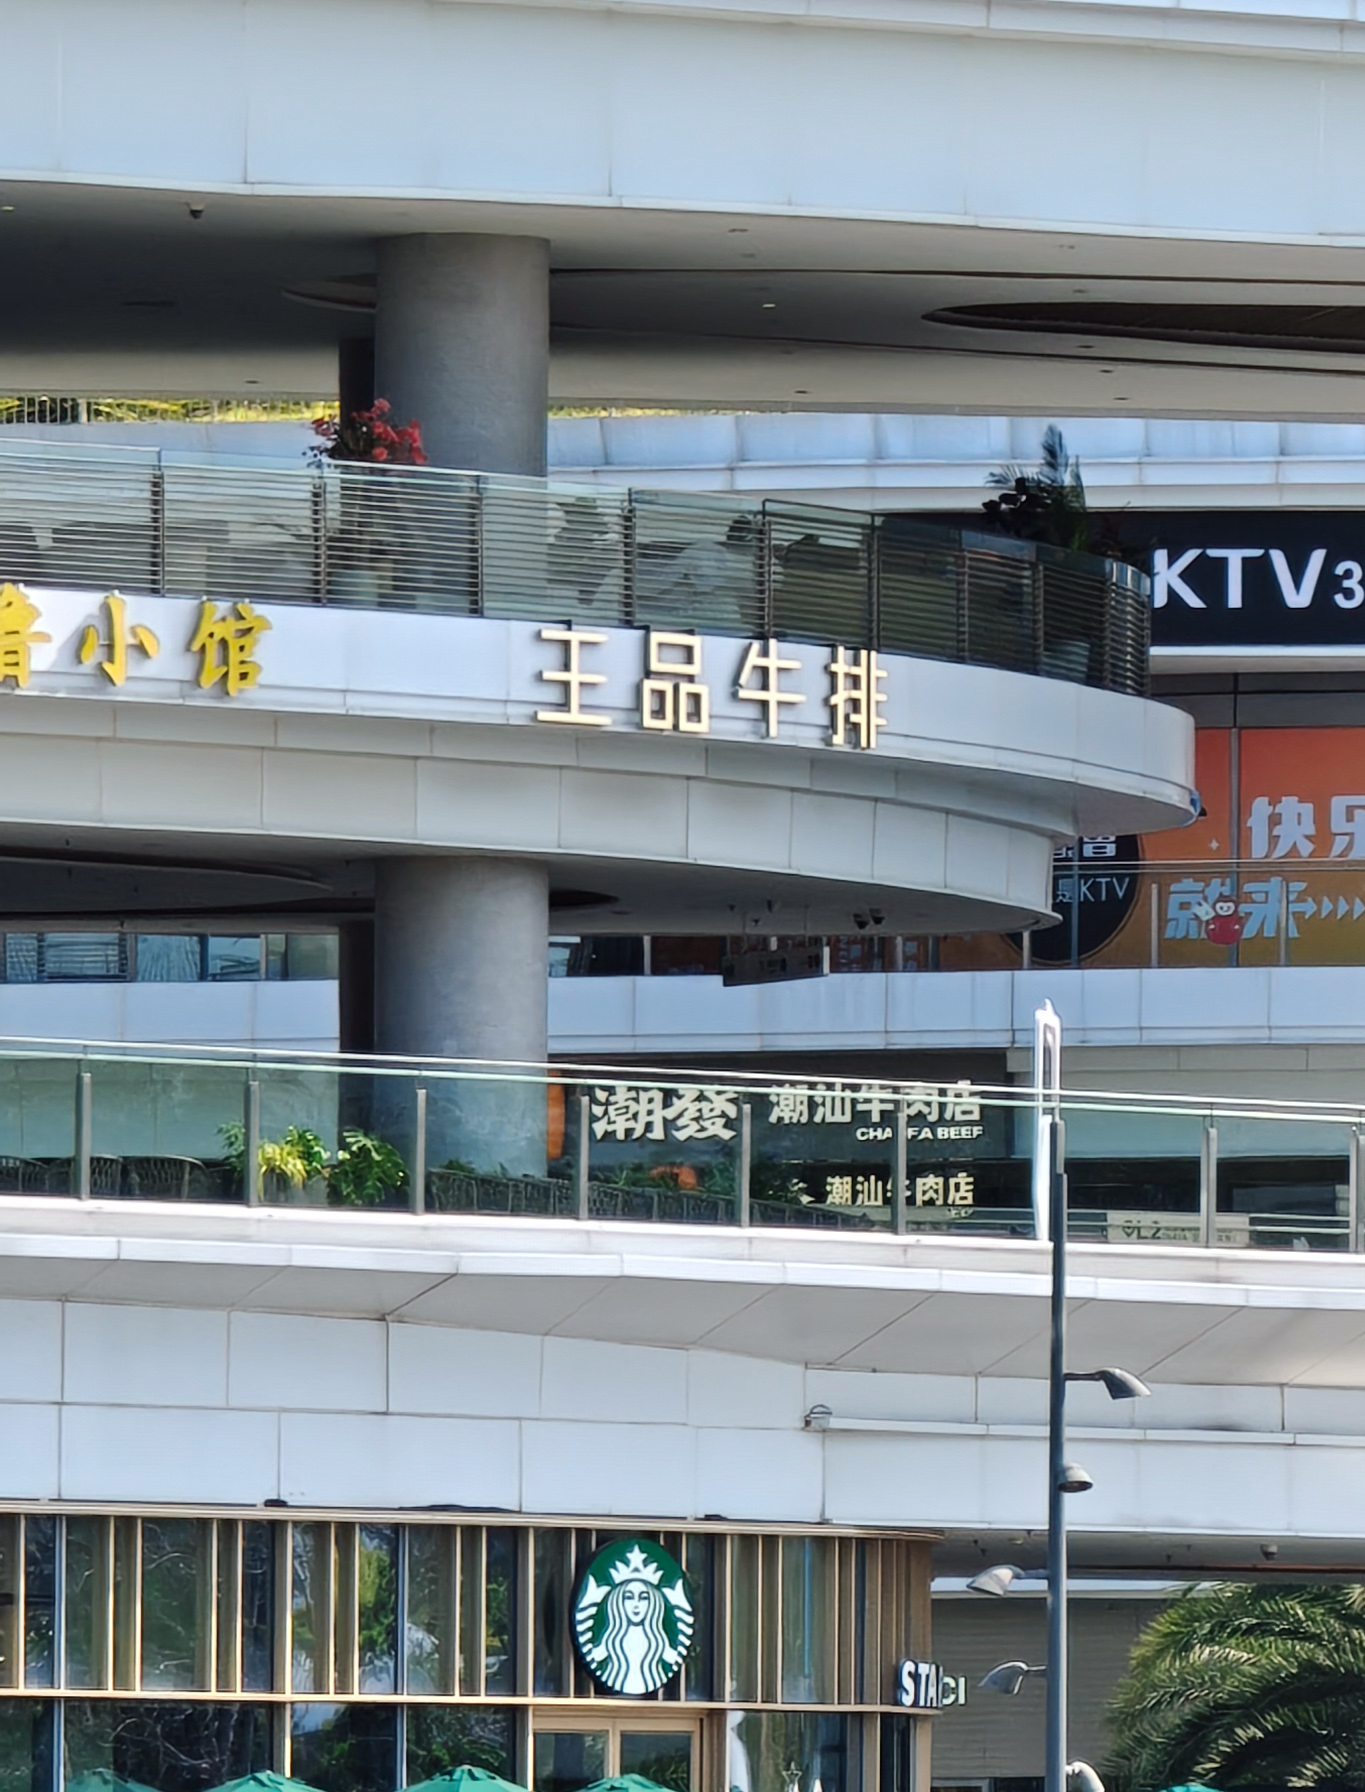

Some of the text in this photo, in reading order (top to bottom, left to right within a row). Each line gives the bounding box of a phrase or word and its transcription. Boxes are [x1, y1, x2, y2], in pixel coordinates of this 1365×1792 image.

[1153, 549, 1327, 609] KTV
[536, 628, 889, 750] 王品牛排
[855, 1125, 984, 1142] CHAFA BEEF
